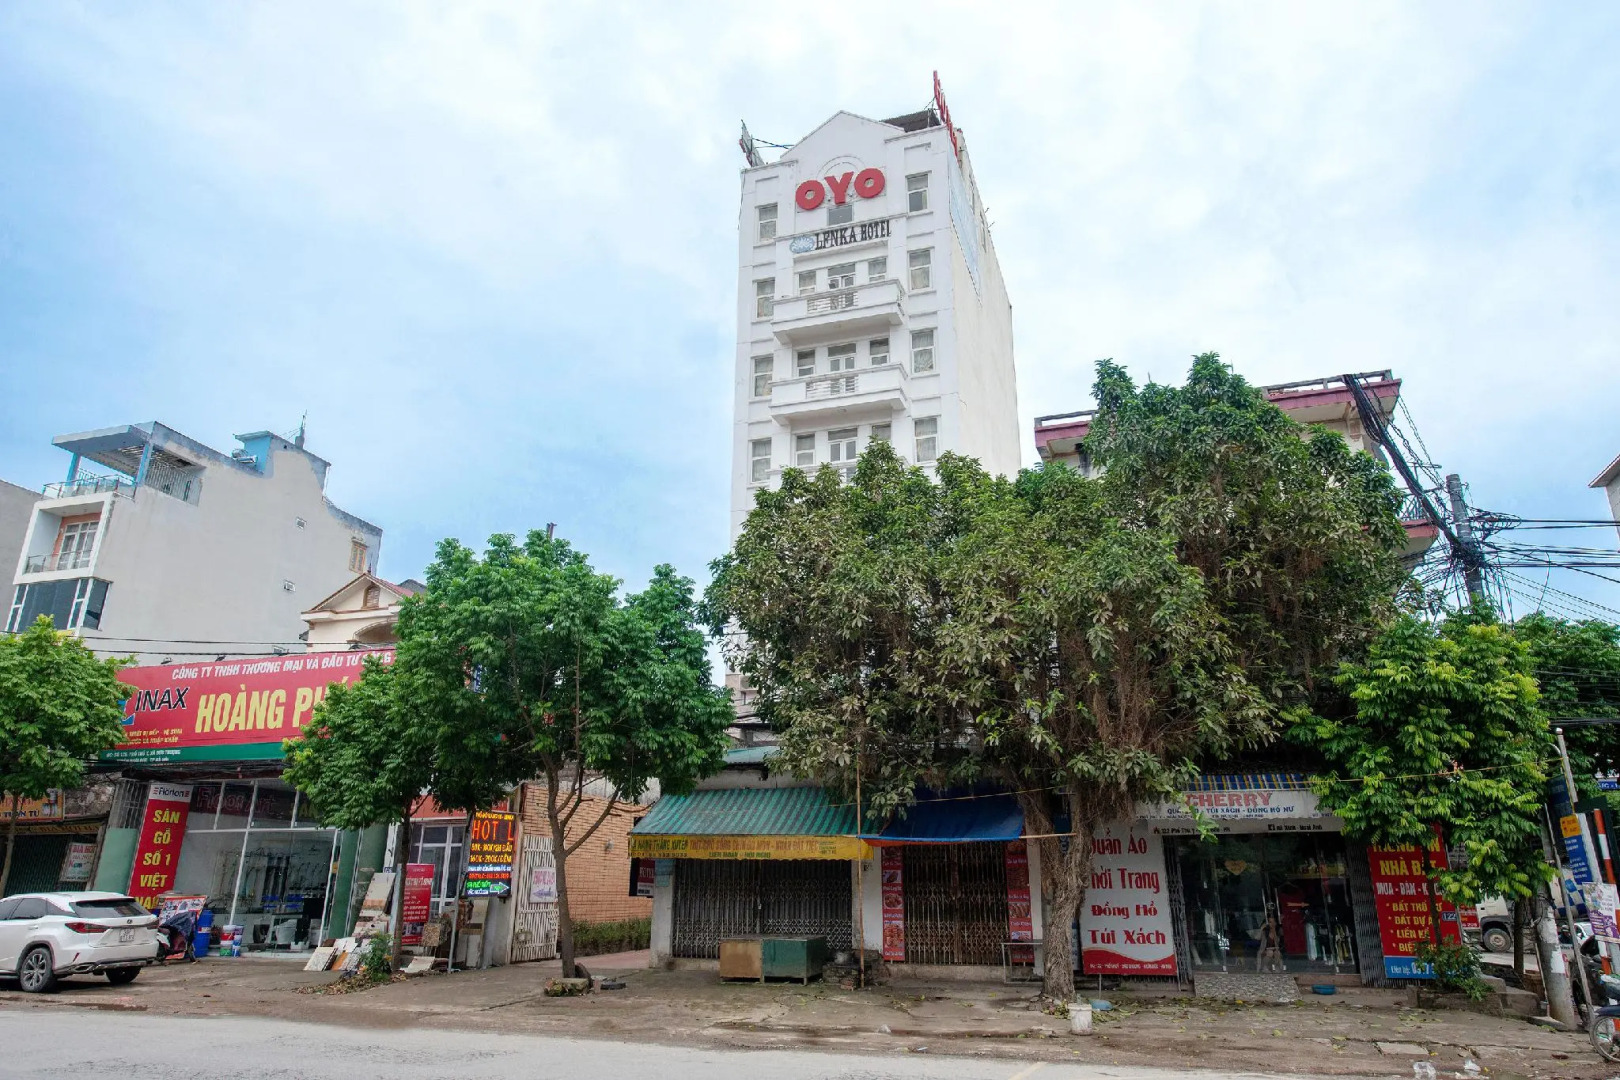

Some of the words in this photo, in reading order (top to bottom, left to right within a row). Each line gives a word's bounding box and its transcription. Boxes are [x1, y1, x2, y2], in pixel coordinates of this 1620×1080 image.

[795, 167, 886, 212] OYO
[860, 220, 892, 241] HOTEL
[172, 666, 199, 680] CÔNG
[200, 664, 213, 678] TY
[283, 659, 304, 675] MẠI
[306, 656, 319, 670] VÀ
[135, 686, 190, 713] INAX
[195, 684, 286, 733] HOÀNG
[1185, 792, 1274, 808] CHERRY
[1128, 826, 1148, 855] Áo
[165, 853, 171, 866] 1
[1380, 857, 1409, 876] NHÀ
[140, 872, 167, 891] VIỆT
[1117, 867, 1160, 894] Trang
[1376, 882, 1395, 895] MUA
[1091, 901, 1130, 919] Đồng
[1135, 900, 1158, 917] Hồ
[1088, 928, 1116, 945] Túi
[1123, 928, 1166, 945] Xách
